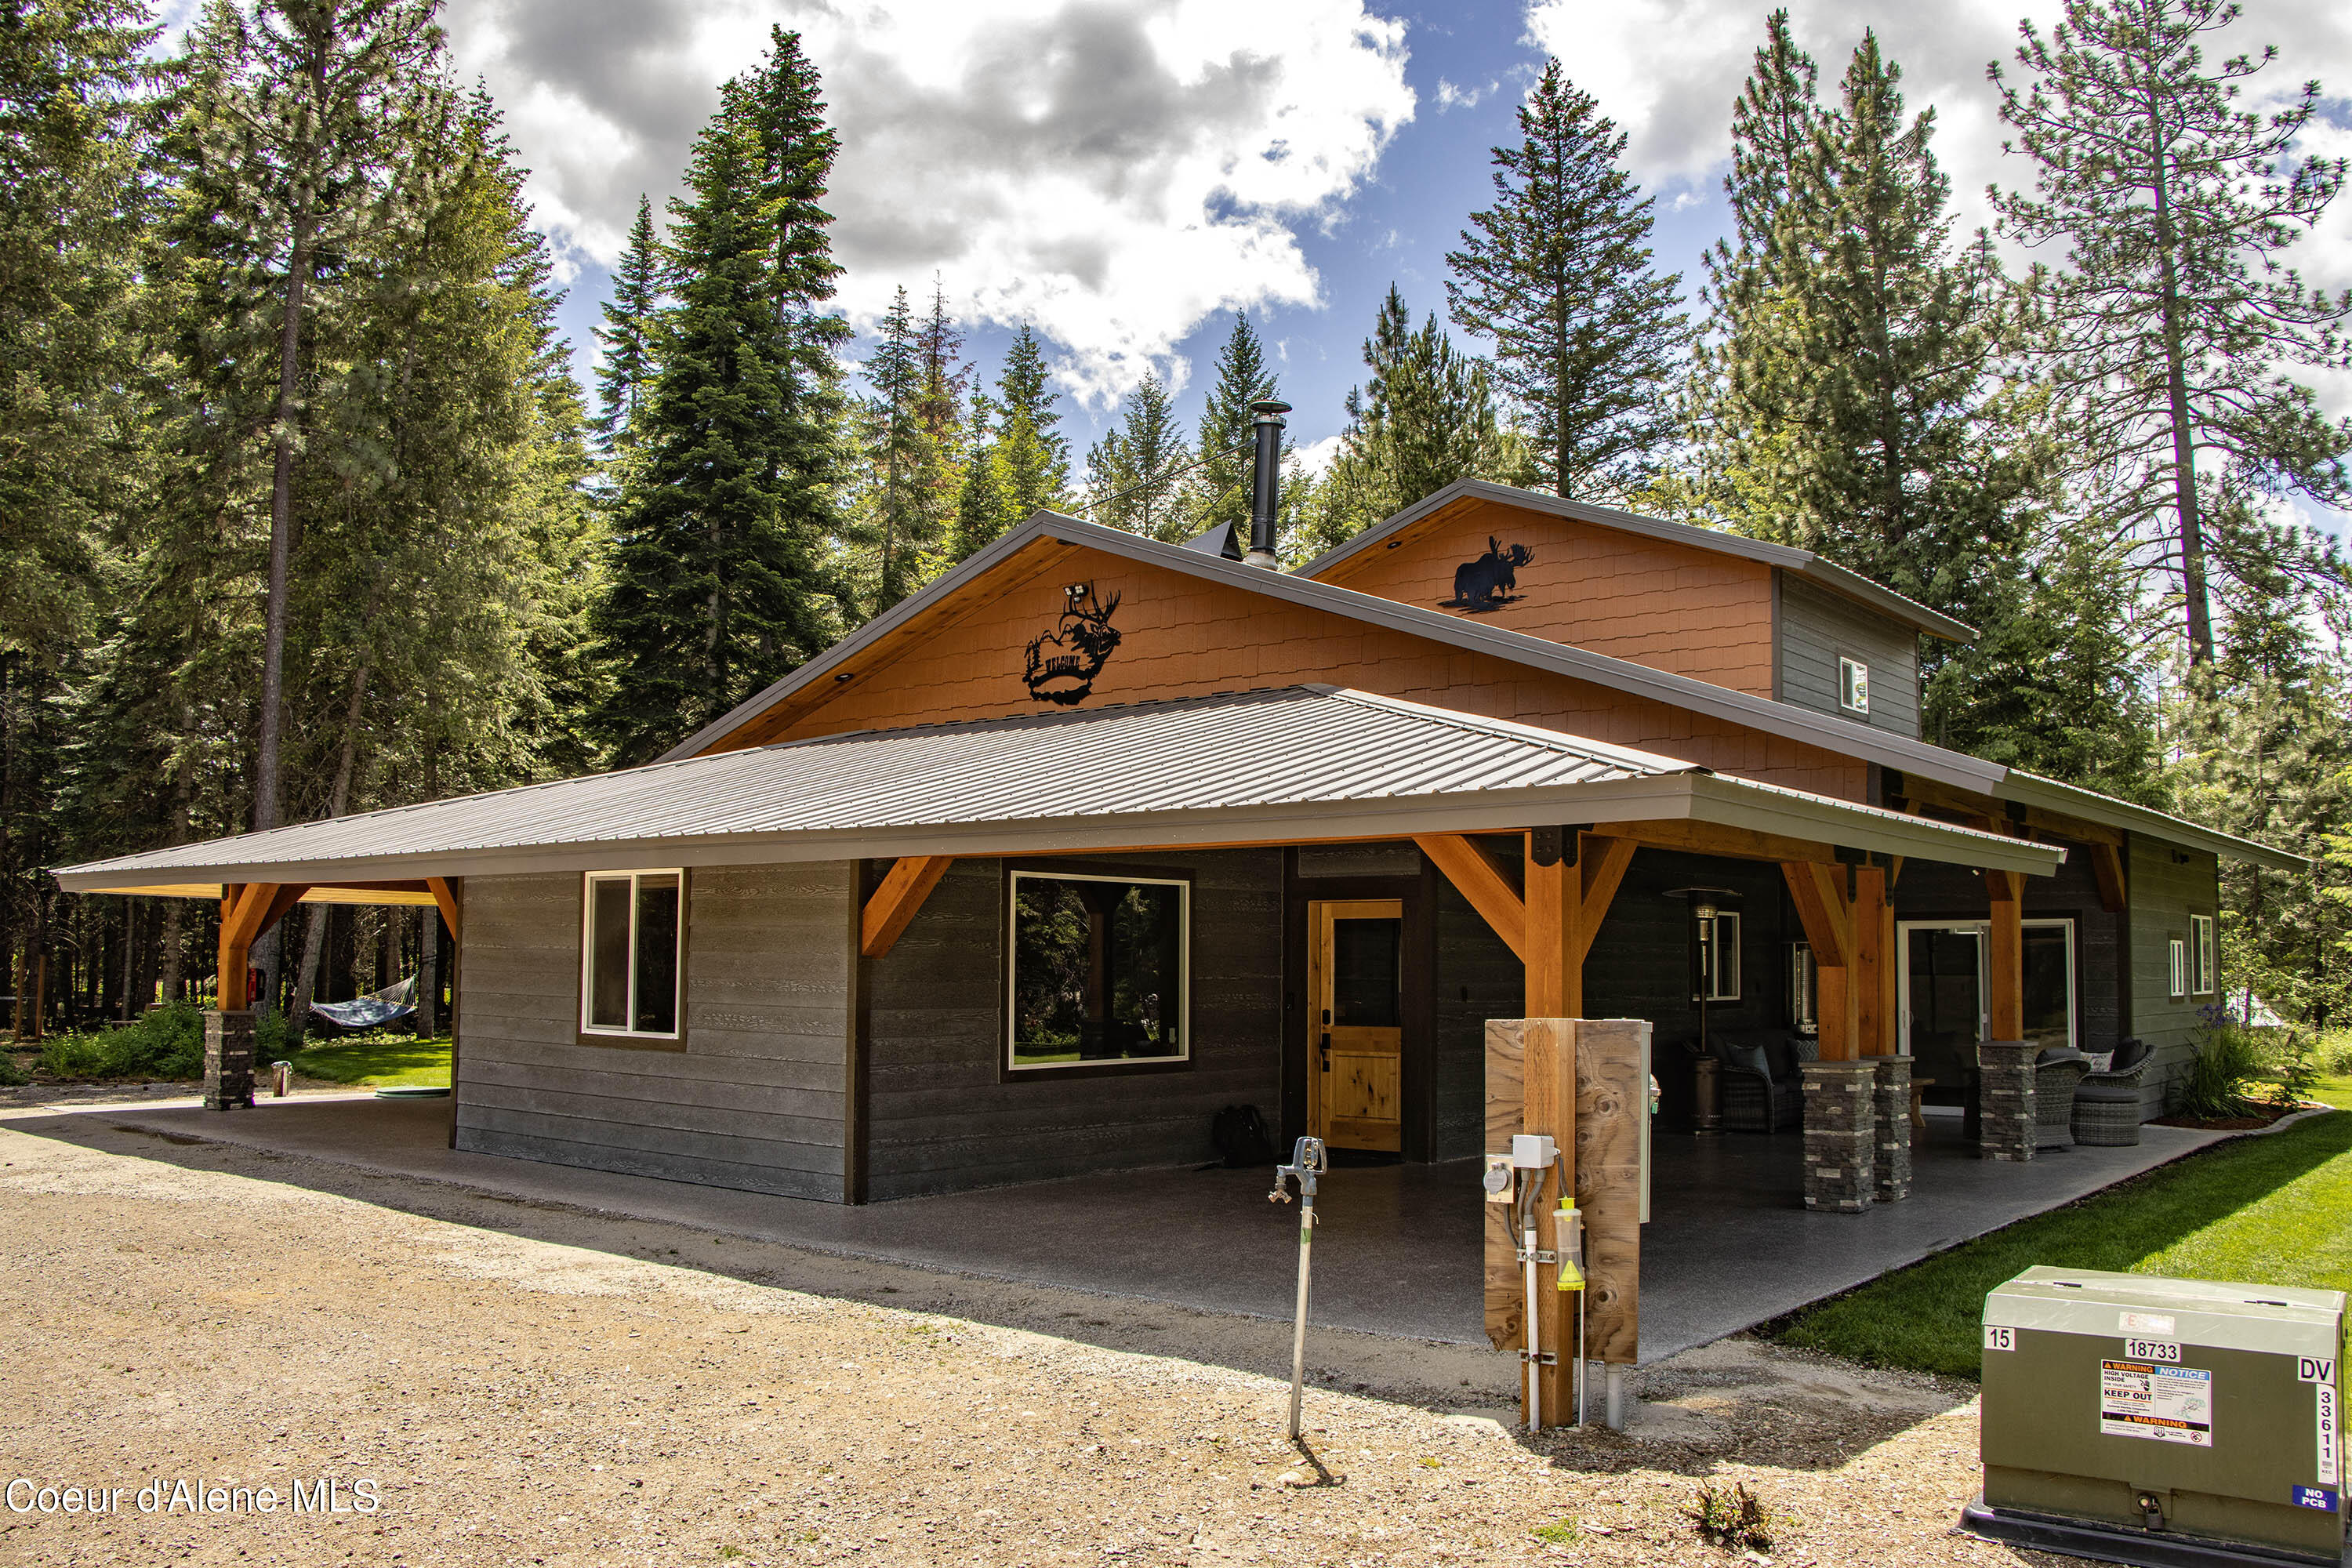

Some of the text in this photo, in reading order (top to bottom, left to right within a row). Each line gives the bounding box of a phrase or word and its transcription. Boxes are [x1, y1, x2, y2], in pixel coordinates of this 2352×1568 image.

[1045, 655, 1080, 671] WELCOME
[1991, 1328, 2010, 1348] 15
[2129, 1341, 2177, 1359] 18733
[2112, 1363, 2154, 1373] WARNING
[2160, 1367, 2206, 1380] NOTICE
[2300, 1358, 2331, 1381] DV
[2103, 1389, 2130, 1398] KEEP
[2133, 1415, 2187, 1428] WARNING
[2321, 1392, 2331, 1458] 33611
[2305, 1488, 2324, 1499] NO
[2301, 1496, 2328, 1508] PCB
